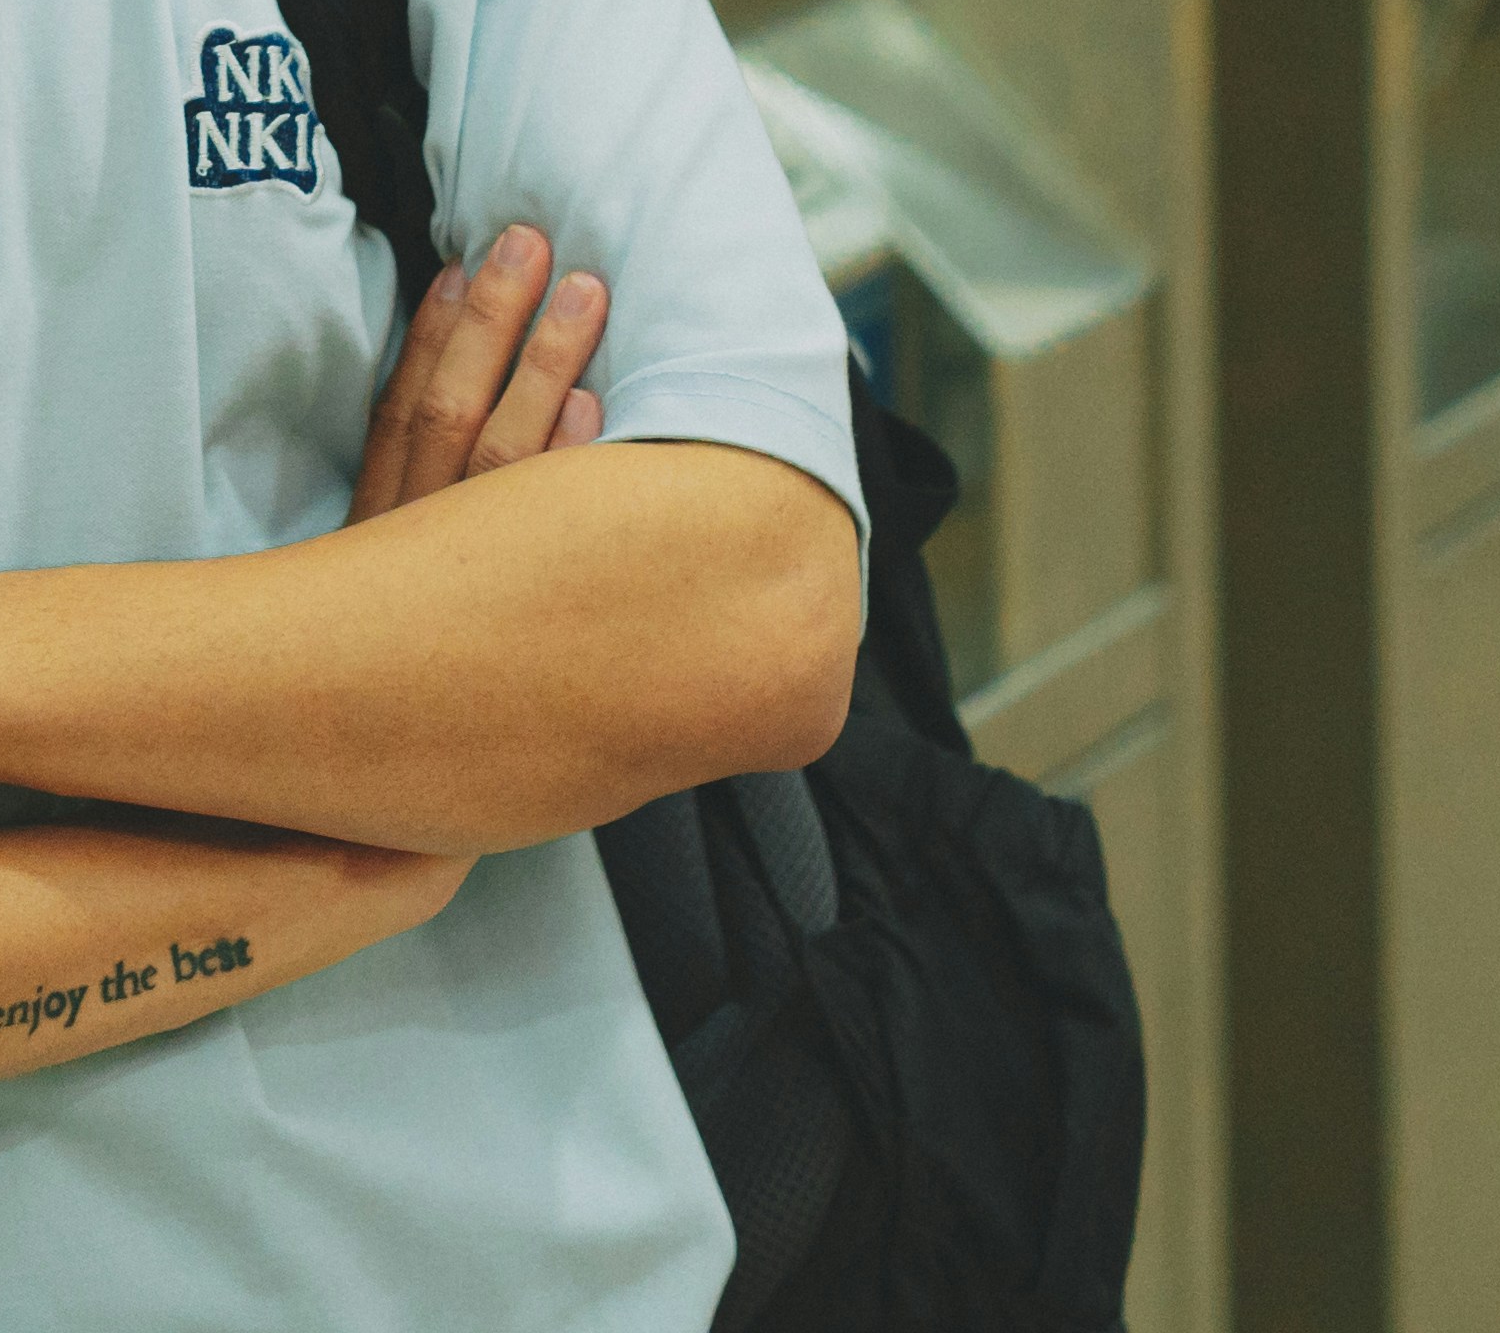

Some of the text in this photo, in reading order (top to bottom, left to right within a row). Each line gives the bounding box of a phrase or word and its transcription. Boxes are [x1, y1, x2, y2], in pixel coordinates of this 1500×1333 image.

[213, 44, 303, 105] NK
[196, 111, 312, 176] NKI
[100, 960, 158, 1004] the
